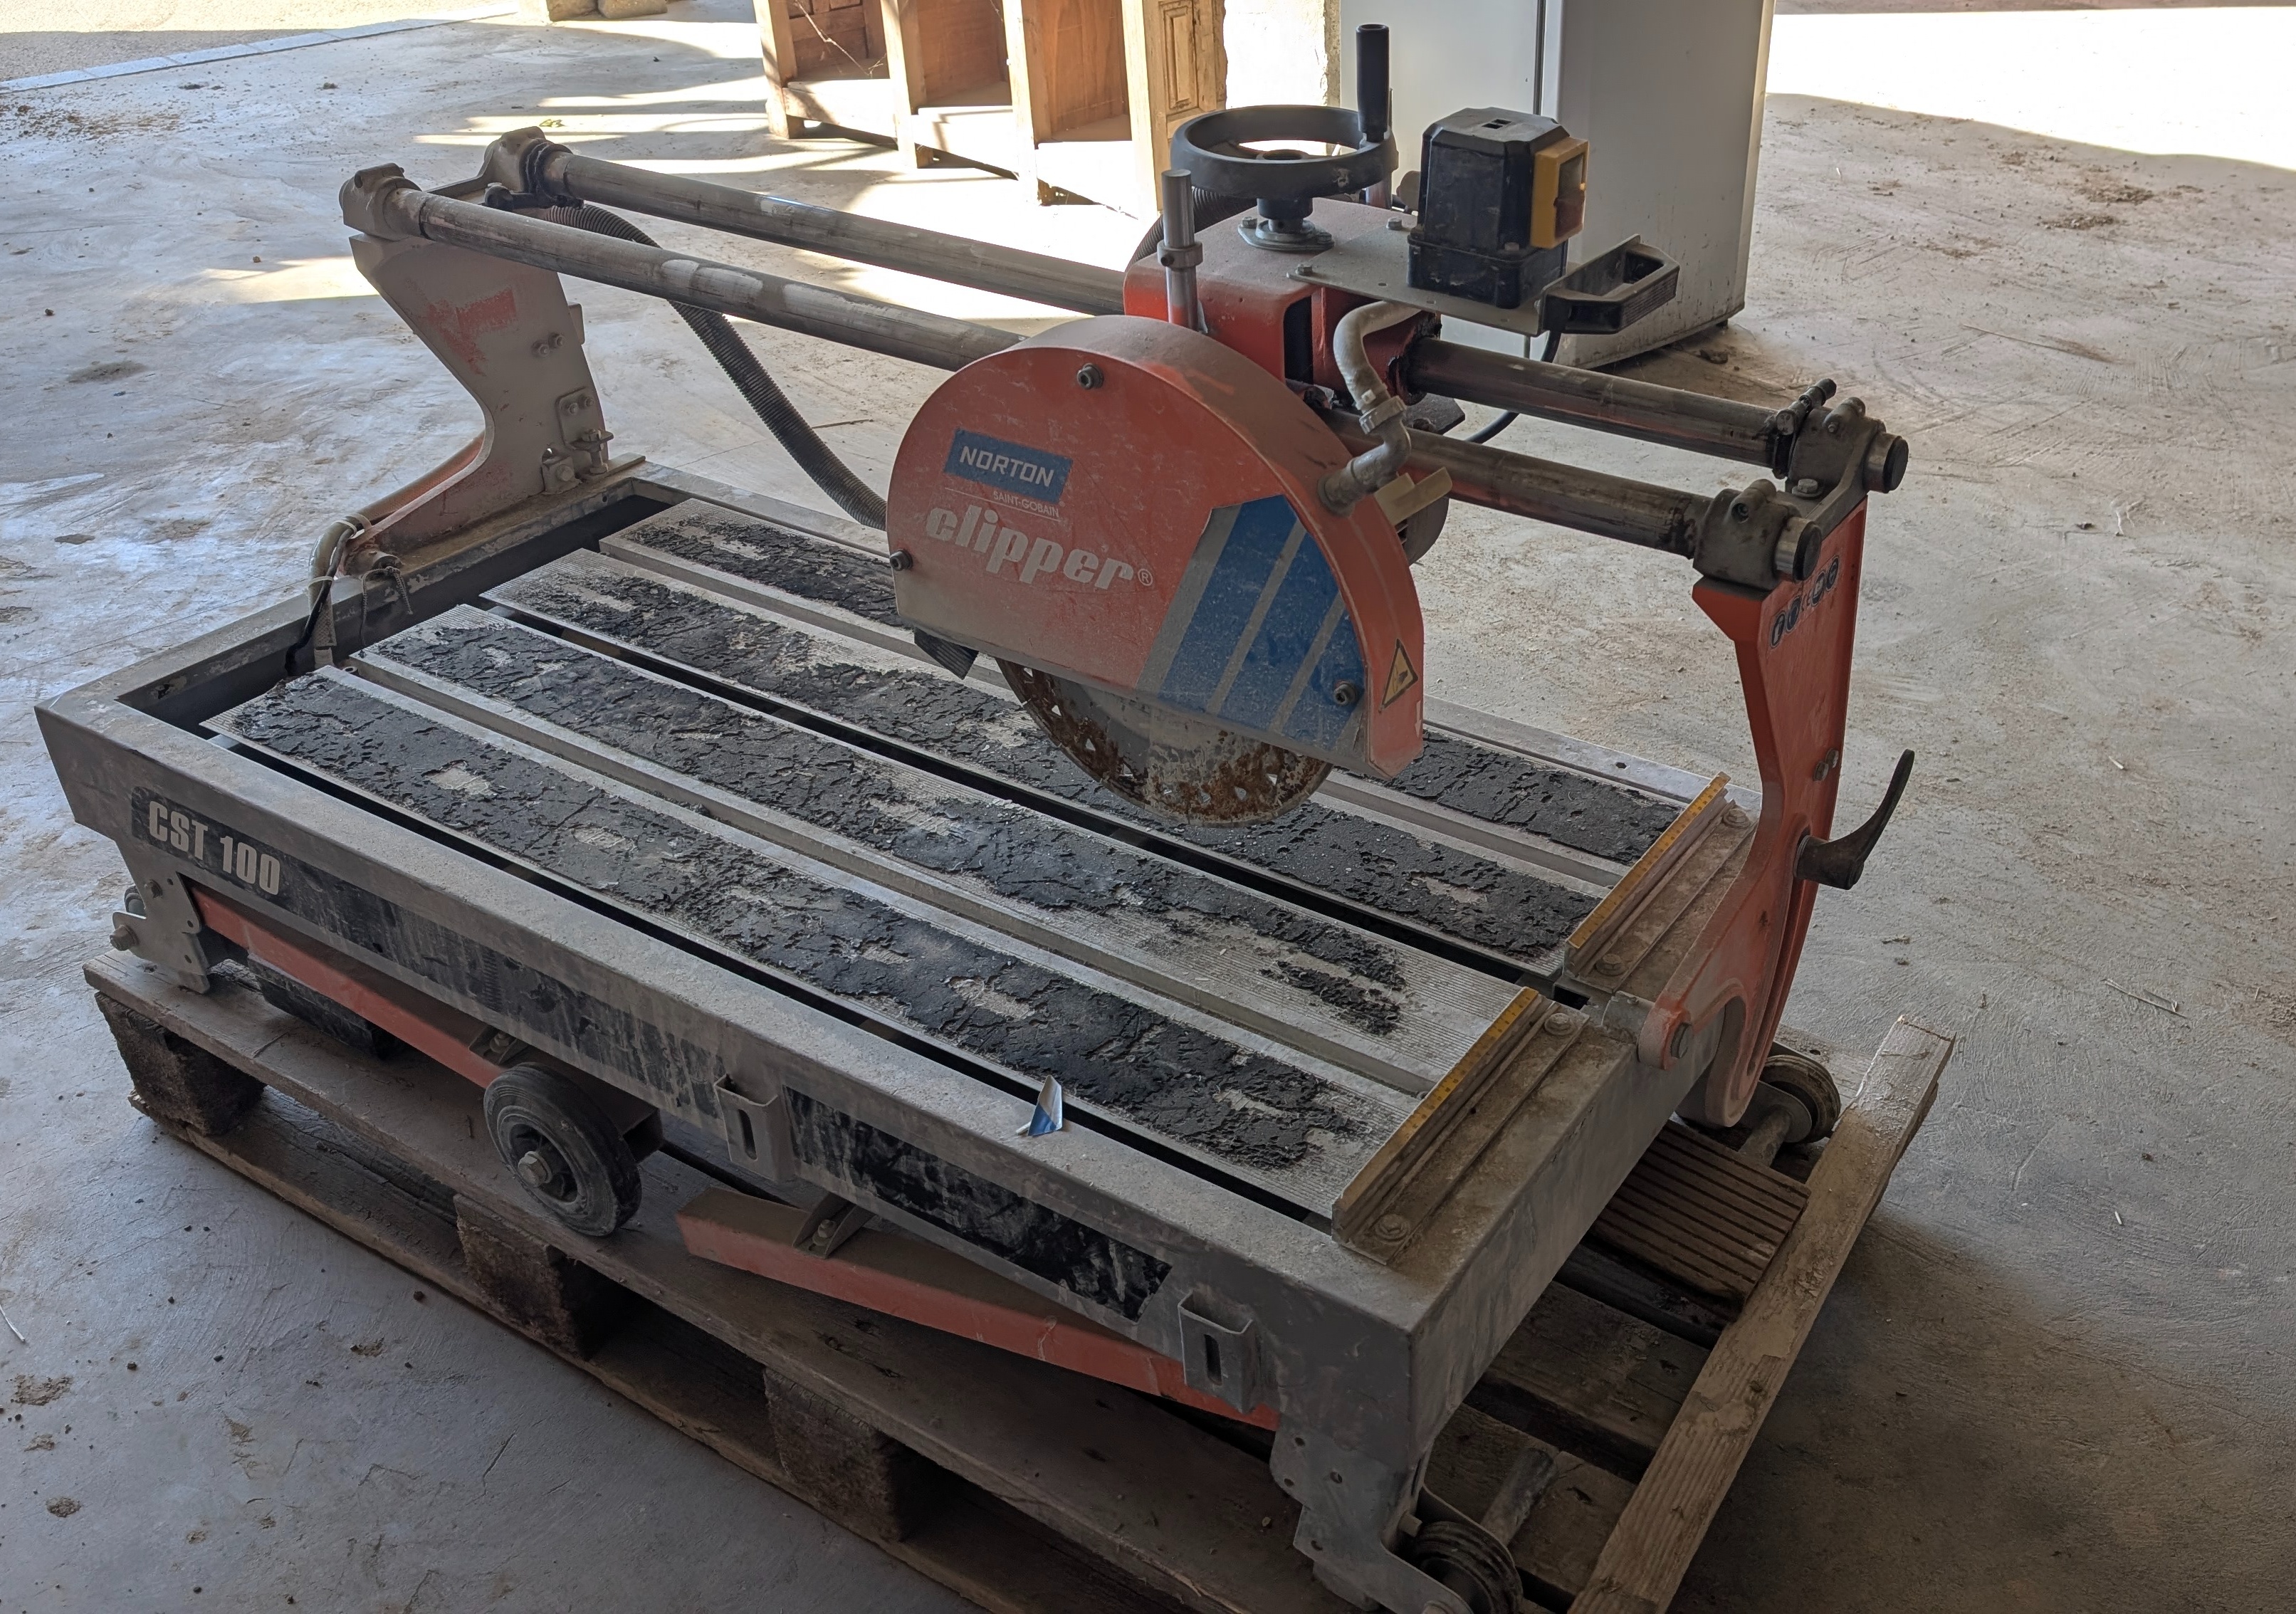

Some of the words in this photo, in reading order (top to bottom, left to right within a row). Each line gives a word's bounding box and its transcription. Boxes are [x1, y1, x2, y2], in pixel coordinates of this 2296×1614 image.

[959, 446, 1054, 487] NORTON
[993, 491, 1059, 518] SAINT-GOBAIN
[149, 800, 209, 861] CST
[219, 835, 281, 896] 100
